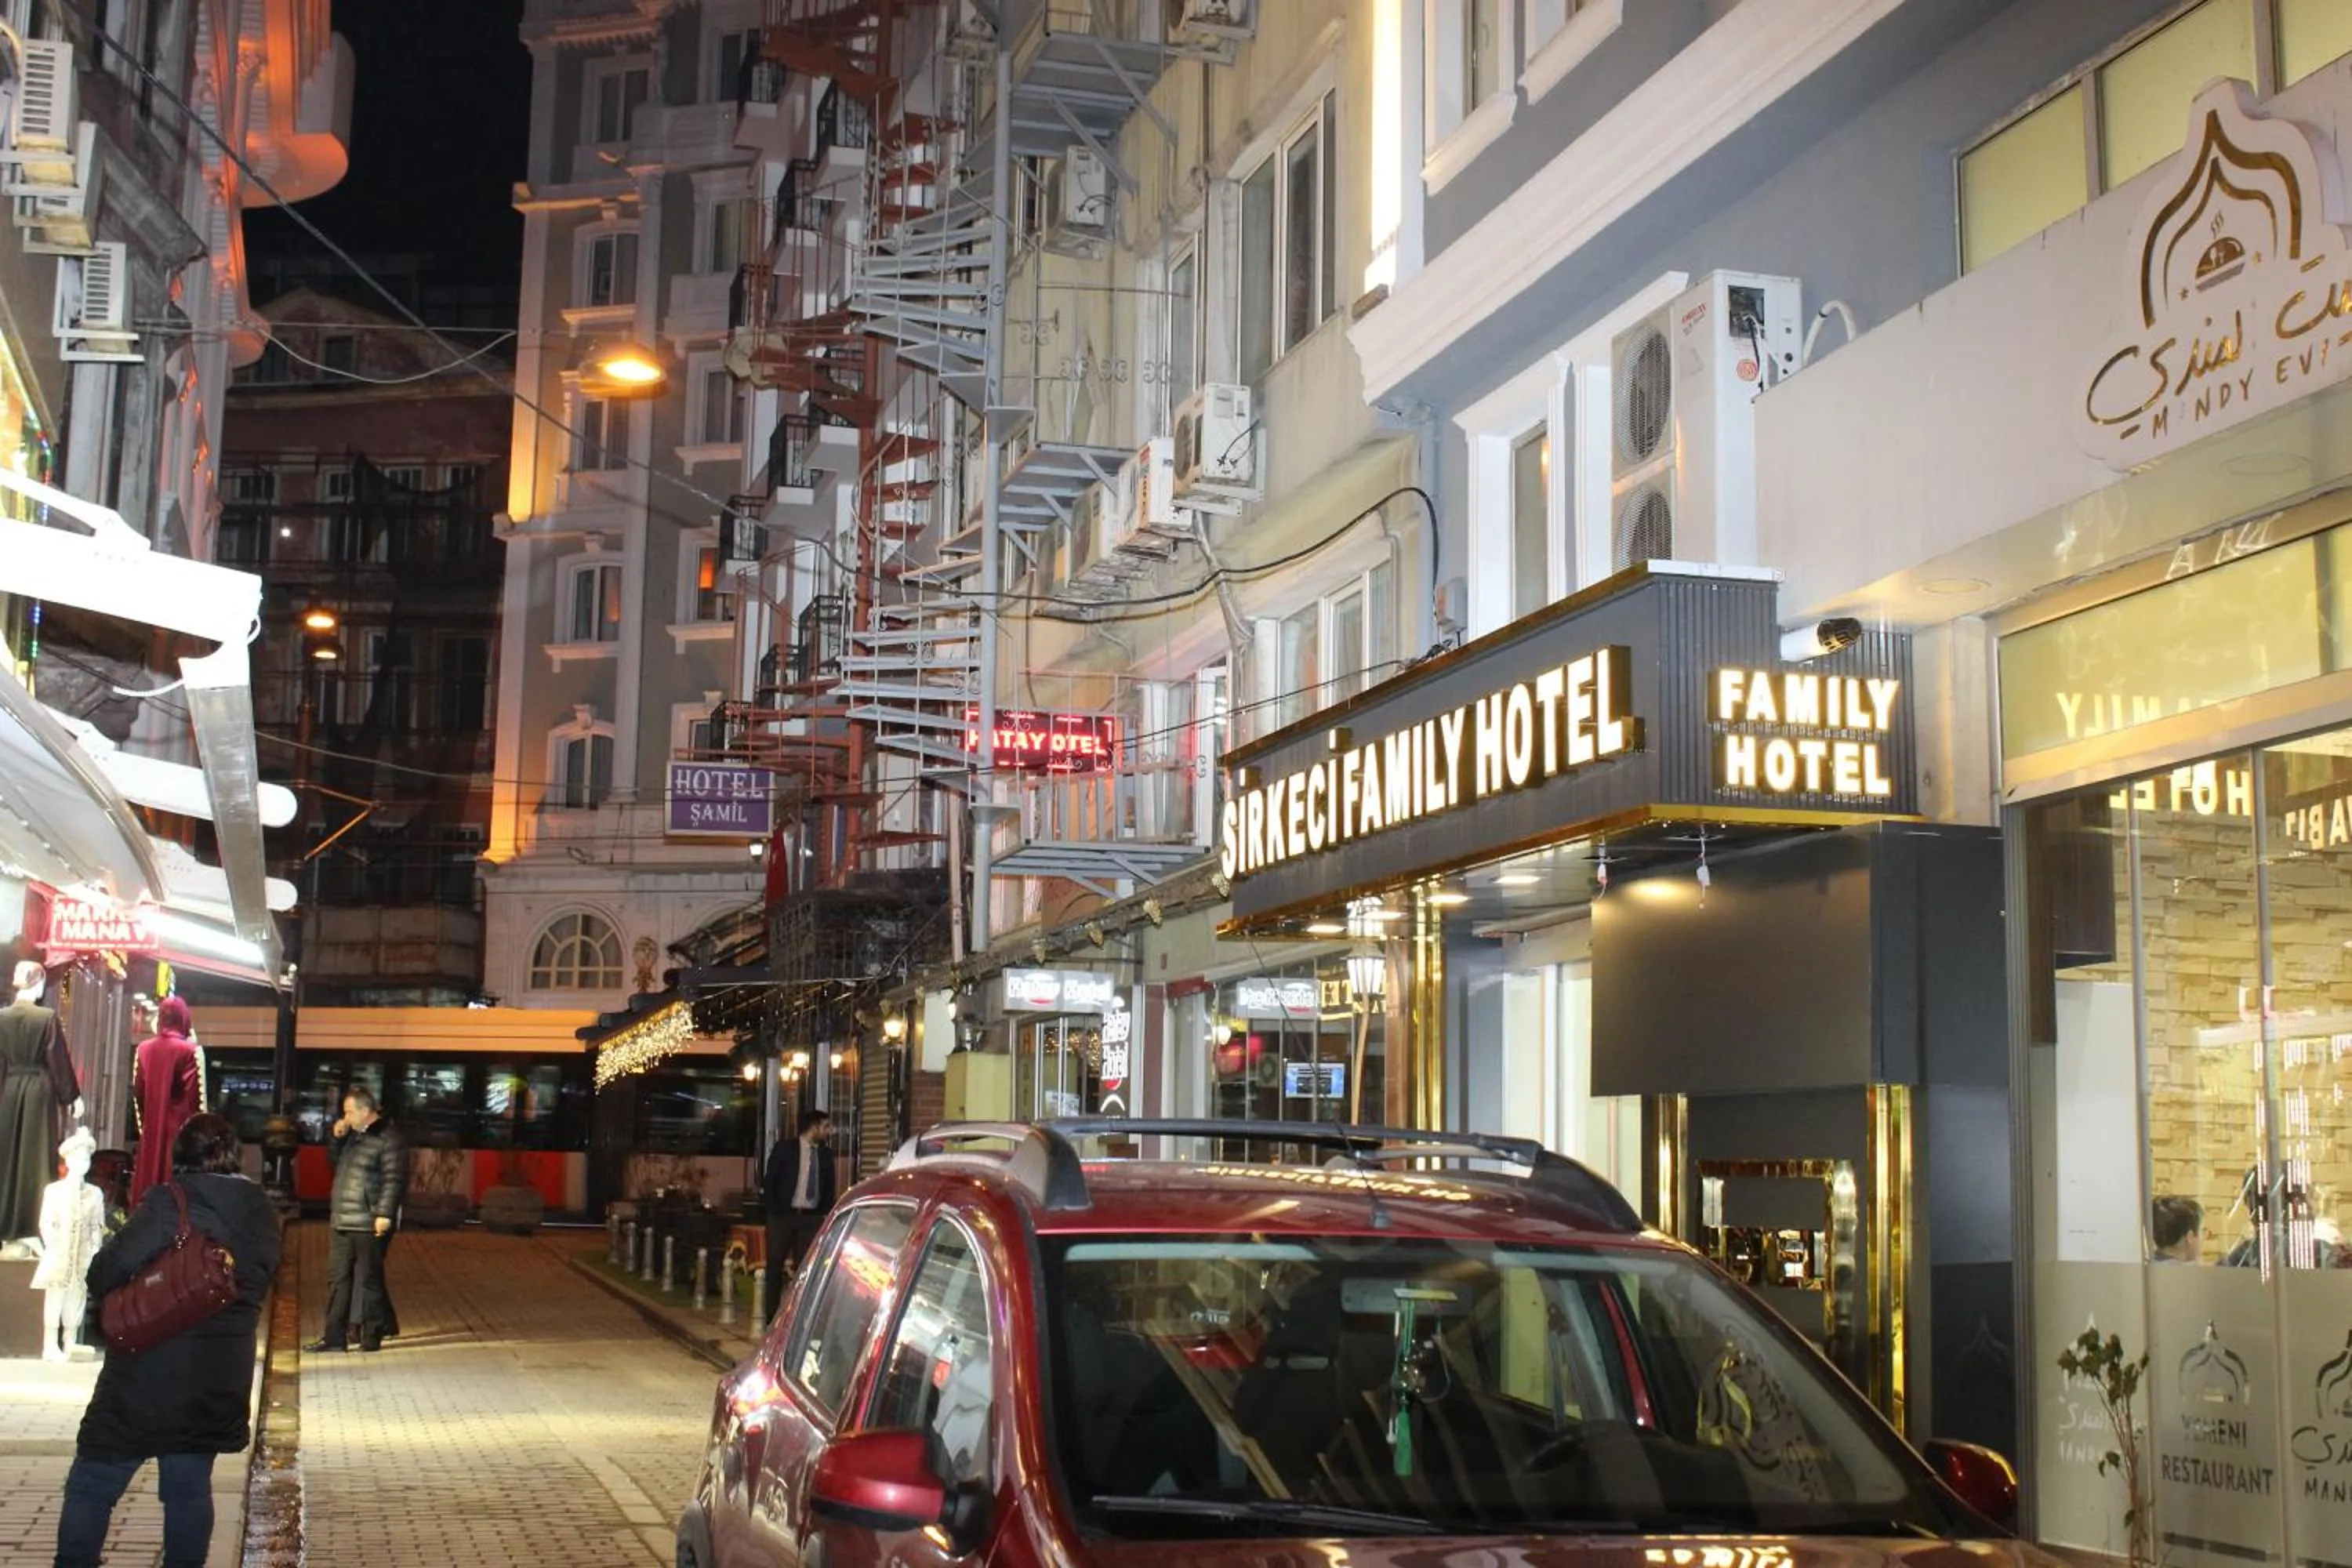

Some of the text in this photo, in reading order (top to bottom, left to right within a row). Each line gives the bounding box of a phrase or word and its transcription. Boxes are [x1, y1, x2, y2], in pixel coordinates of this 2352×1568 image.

[2152, 368, 2254, 438] MNDY
[1719, 669, 1900, 731] FAMILY
[1051, 733, 1107, 756] OTEL
[1343, 706, 1465, 837] FAMILY
[1475, 648, 1624, 796] HOTEL
[675, 768, 764, 799] HOTEL
[1726, 735, 1890, 795] HOTEL
[62, 920, 147, 941] MANAV
[2161, 1454, 2274, 1497] RESTAURANT
[2304, 1475, 2352, 1503] MAN
